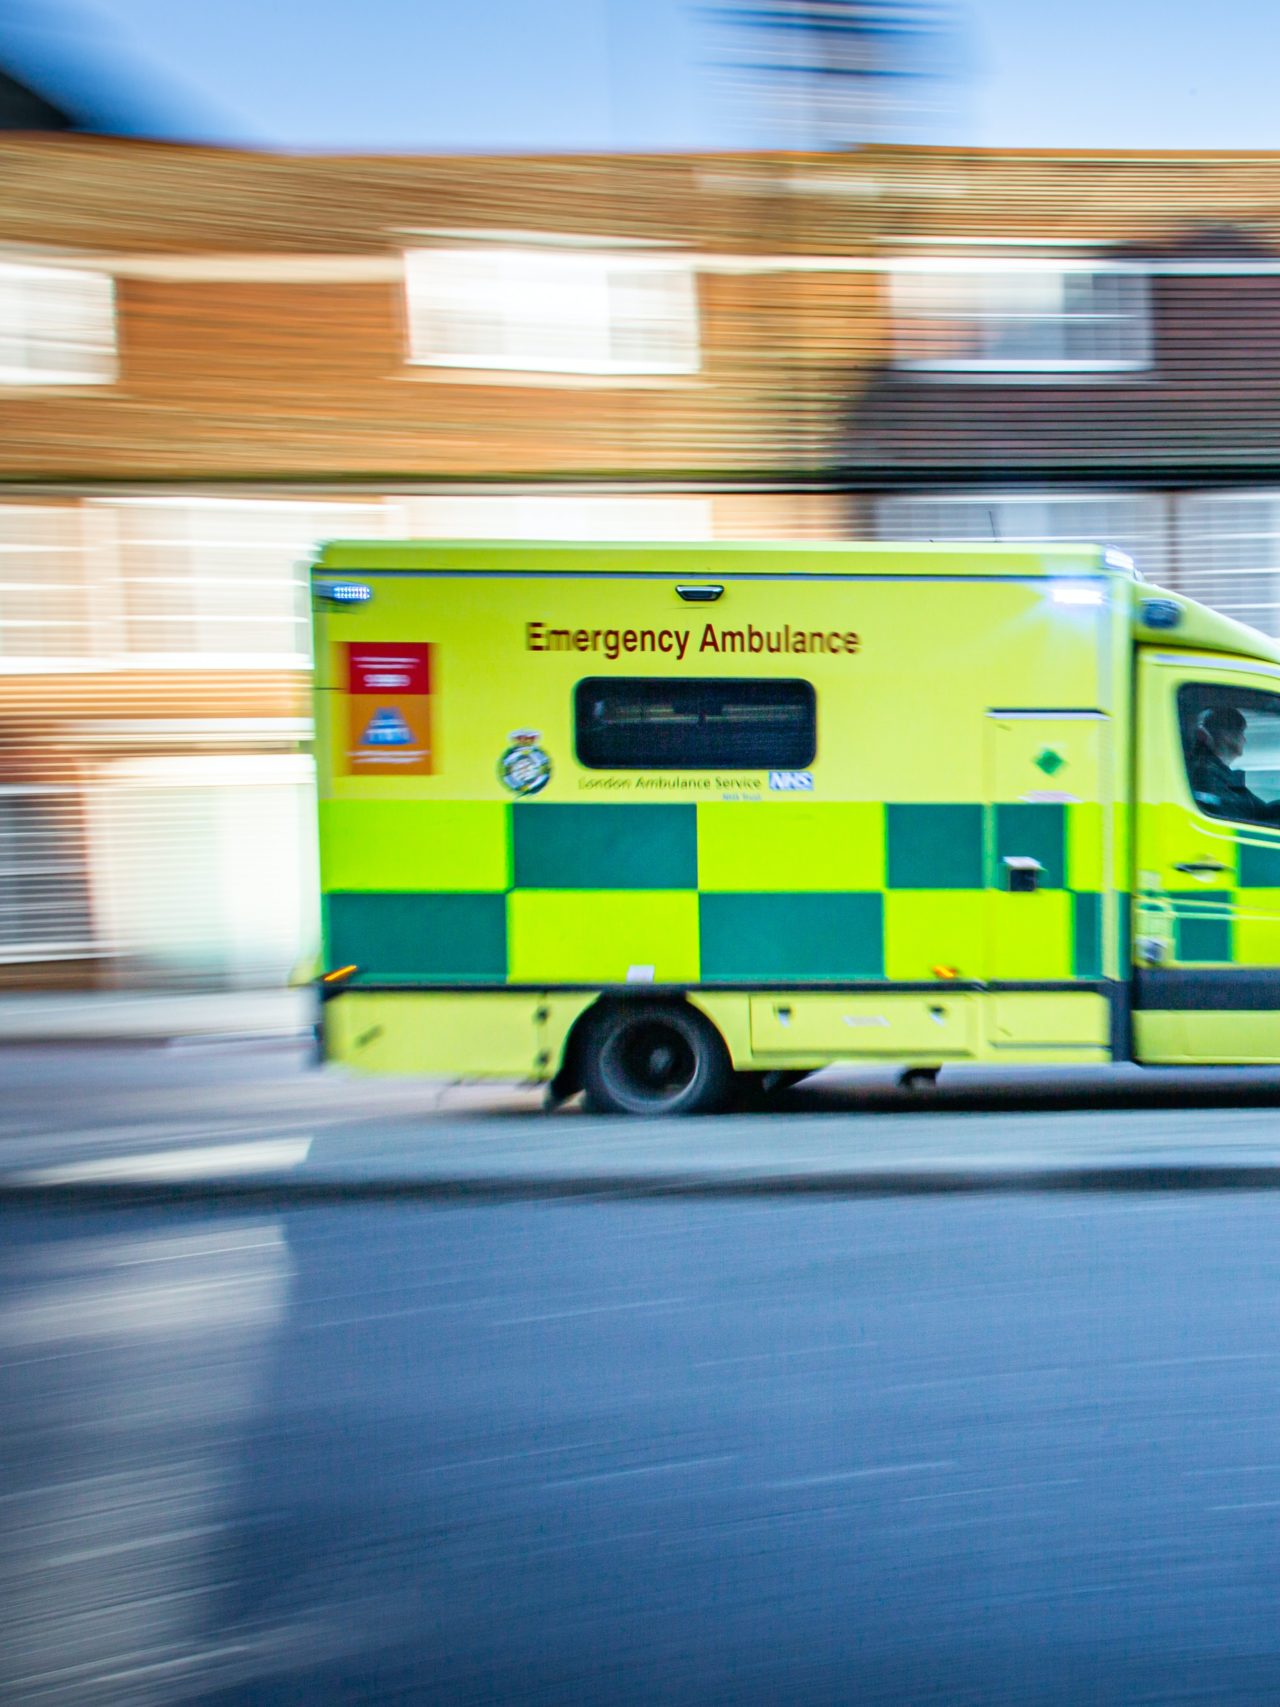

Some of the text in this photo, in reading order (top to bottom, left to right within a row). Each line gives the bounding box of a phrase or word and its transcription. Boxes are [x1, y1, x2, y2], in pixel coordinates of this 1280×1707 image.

[526, 621, 861, 660] Emergency Ambulance
[579, 776, 762, 790] London Ambulance Service
[769, 770, 814, 790] NHS
